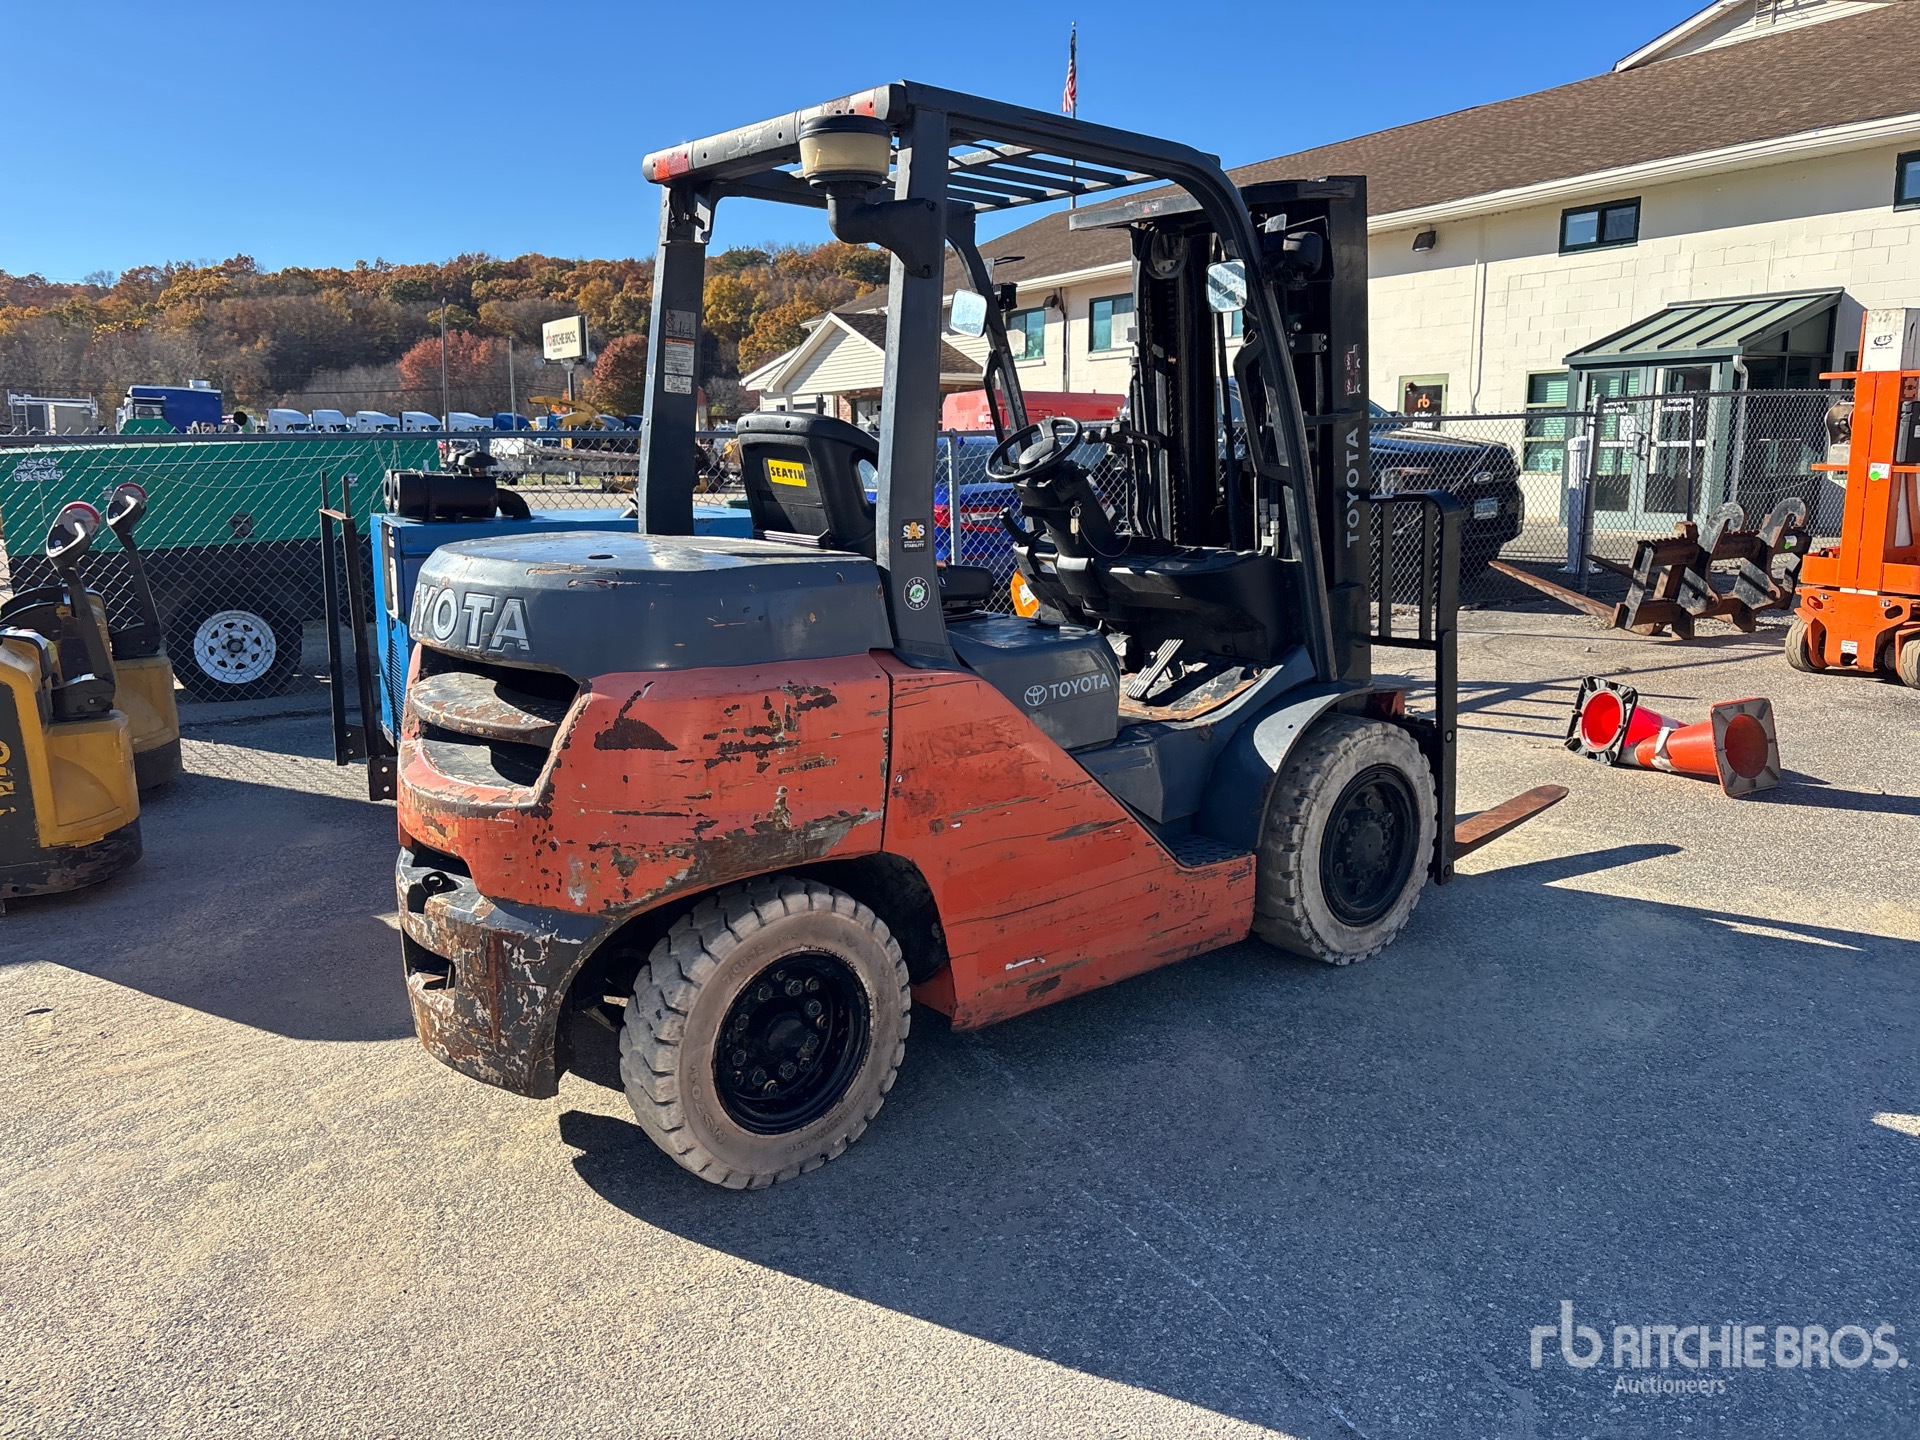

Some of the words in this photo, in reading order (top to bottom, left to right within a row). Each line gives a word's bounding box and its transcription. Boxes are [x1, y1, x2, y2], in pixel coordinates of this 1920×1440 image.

[1417, 394, 1430, 408] rb
[1346, 427, 1360, 548] TOYOTA
[902, 521, 926, 539] SAS
[1049, 673, 1110, 699] TOYOTA
